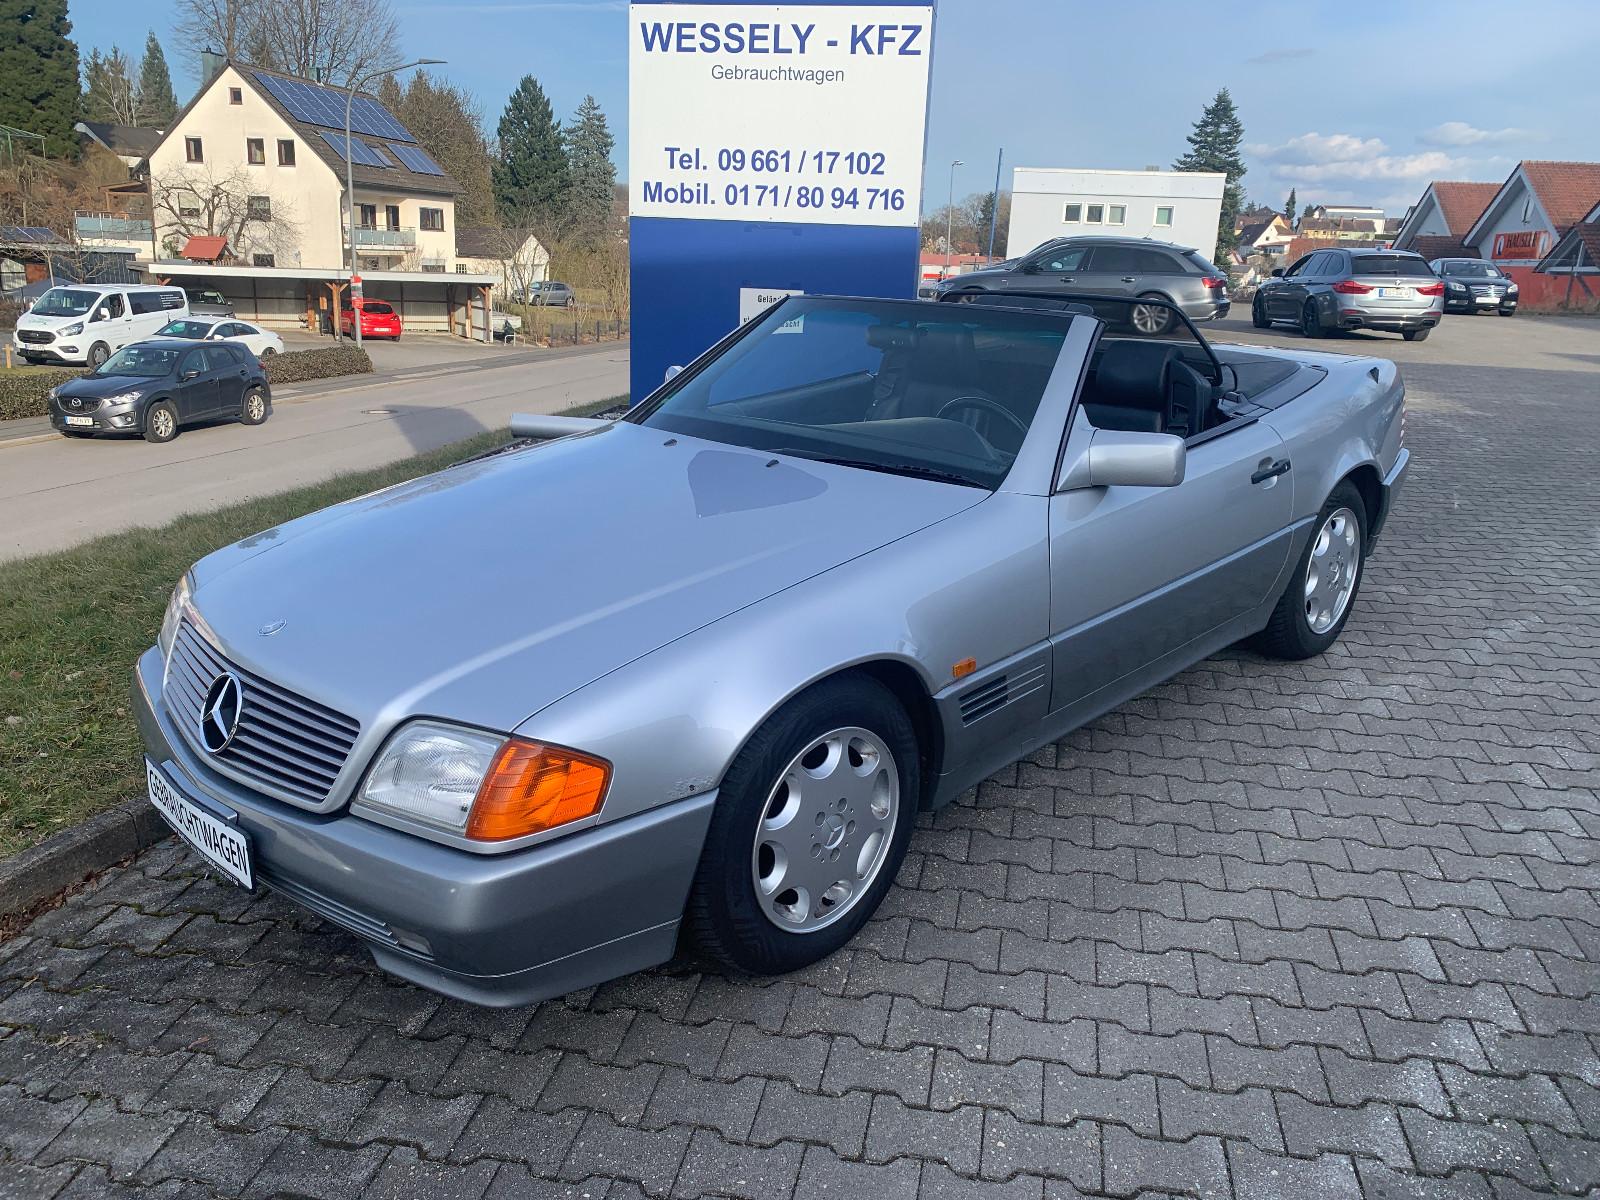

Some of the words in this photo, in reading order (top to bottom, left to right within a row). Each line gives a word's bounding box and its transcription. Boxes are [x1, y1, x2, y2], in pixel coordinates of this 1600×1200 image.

[640, 22, 816, 54] WESSELY
[850, 24, 923, 56] KFZ
[711, 64, 845, 86] Gebrauchtwagen
[664, 146, 708, 171] Tel.
[643, 180, 716, 205] Mobil.
